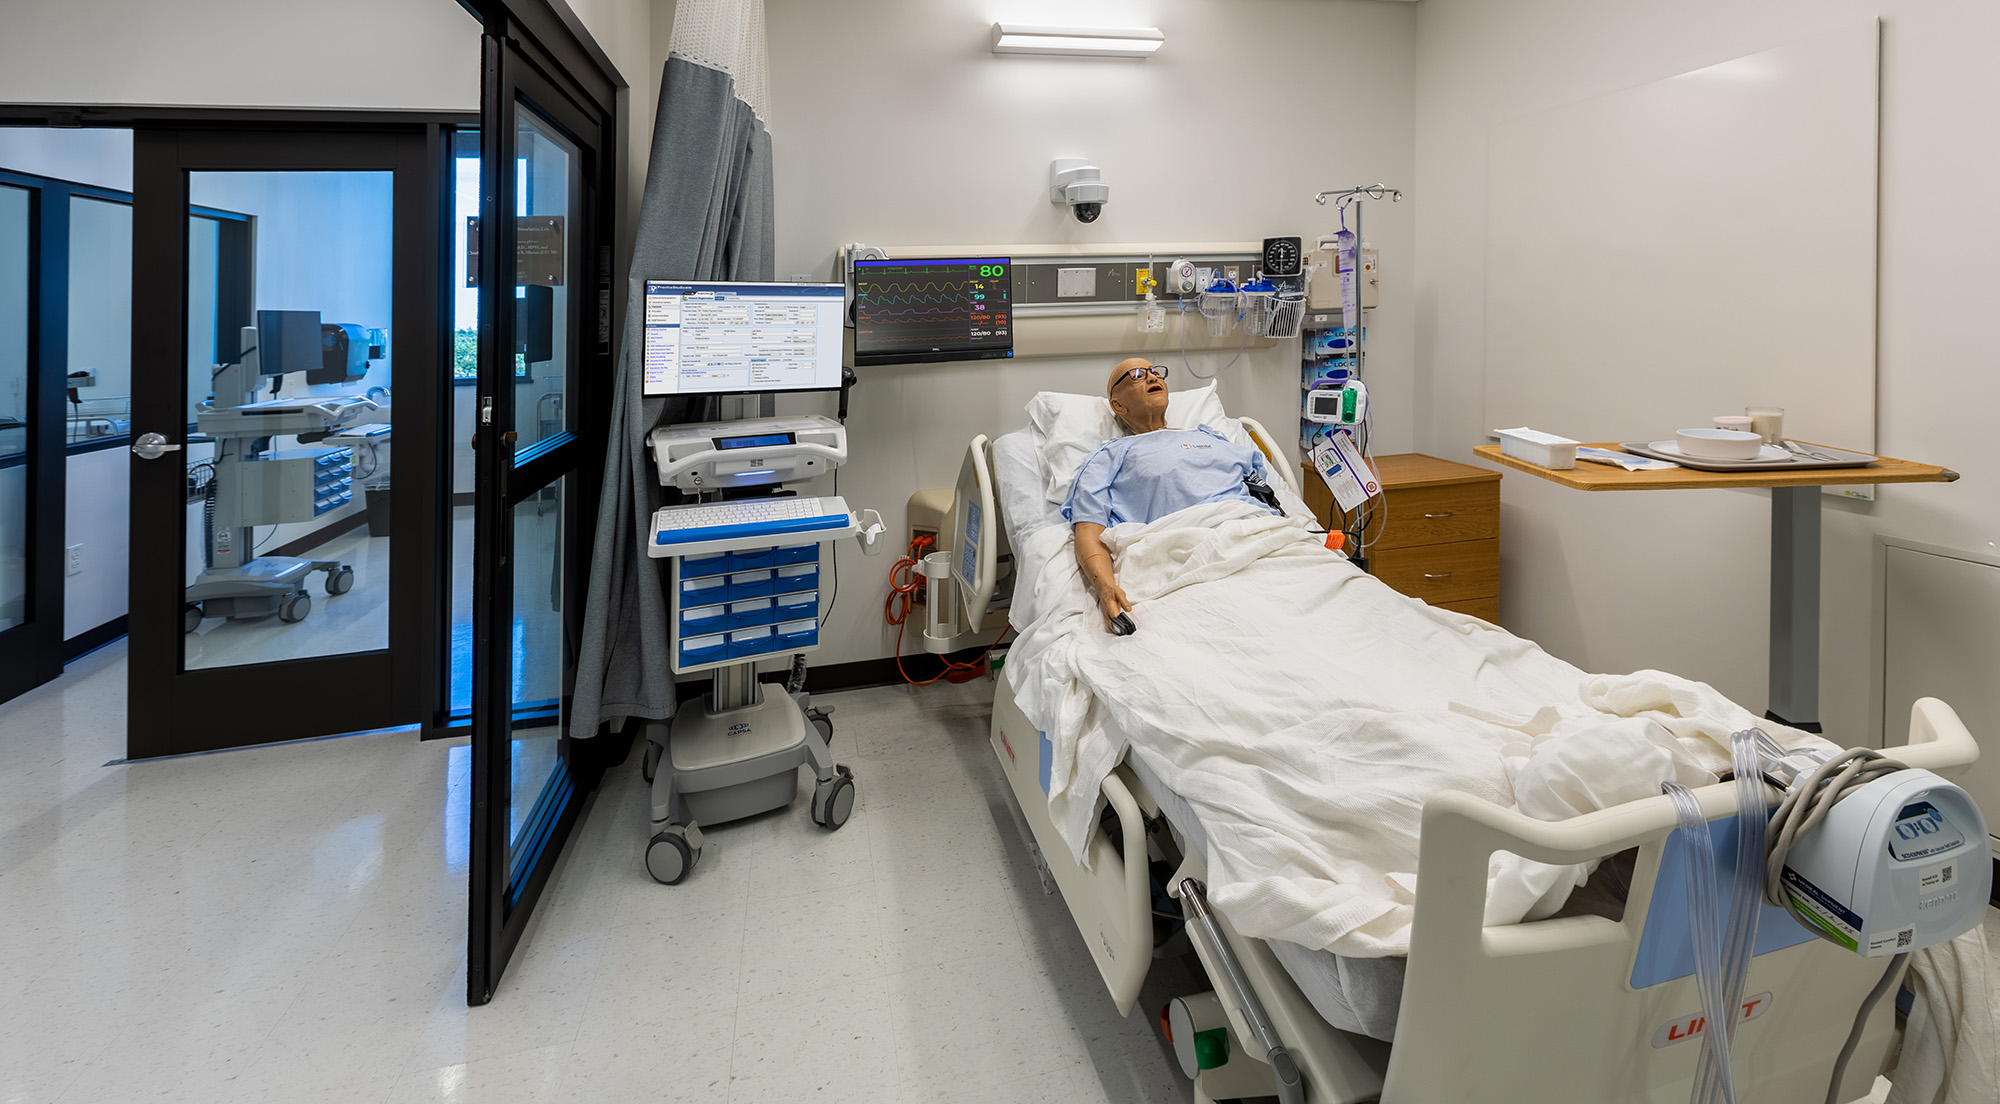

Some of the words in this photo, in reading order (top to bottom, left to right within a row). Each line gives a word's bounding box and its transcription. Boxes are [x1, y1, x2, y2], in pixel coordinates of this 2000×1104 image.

[980, 265, 1004, 277] 80
[727, 728, 752, 736] CAPSA
[1798, 879, 1818, 896] MEDICAL
[1919, 891, 1958, 910] KENDALL
